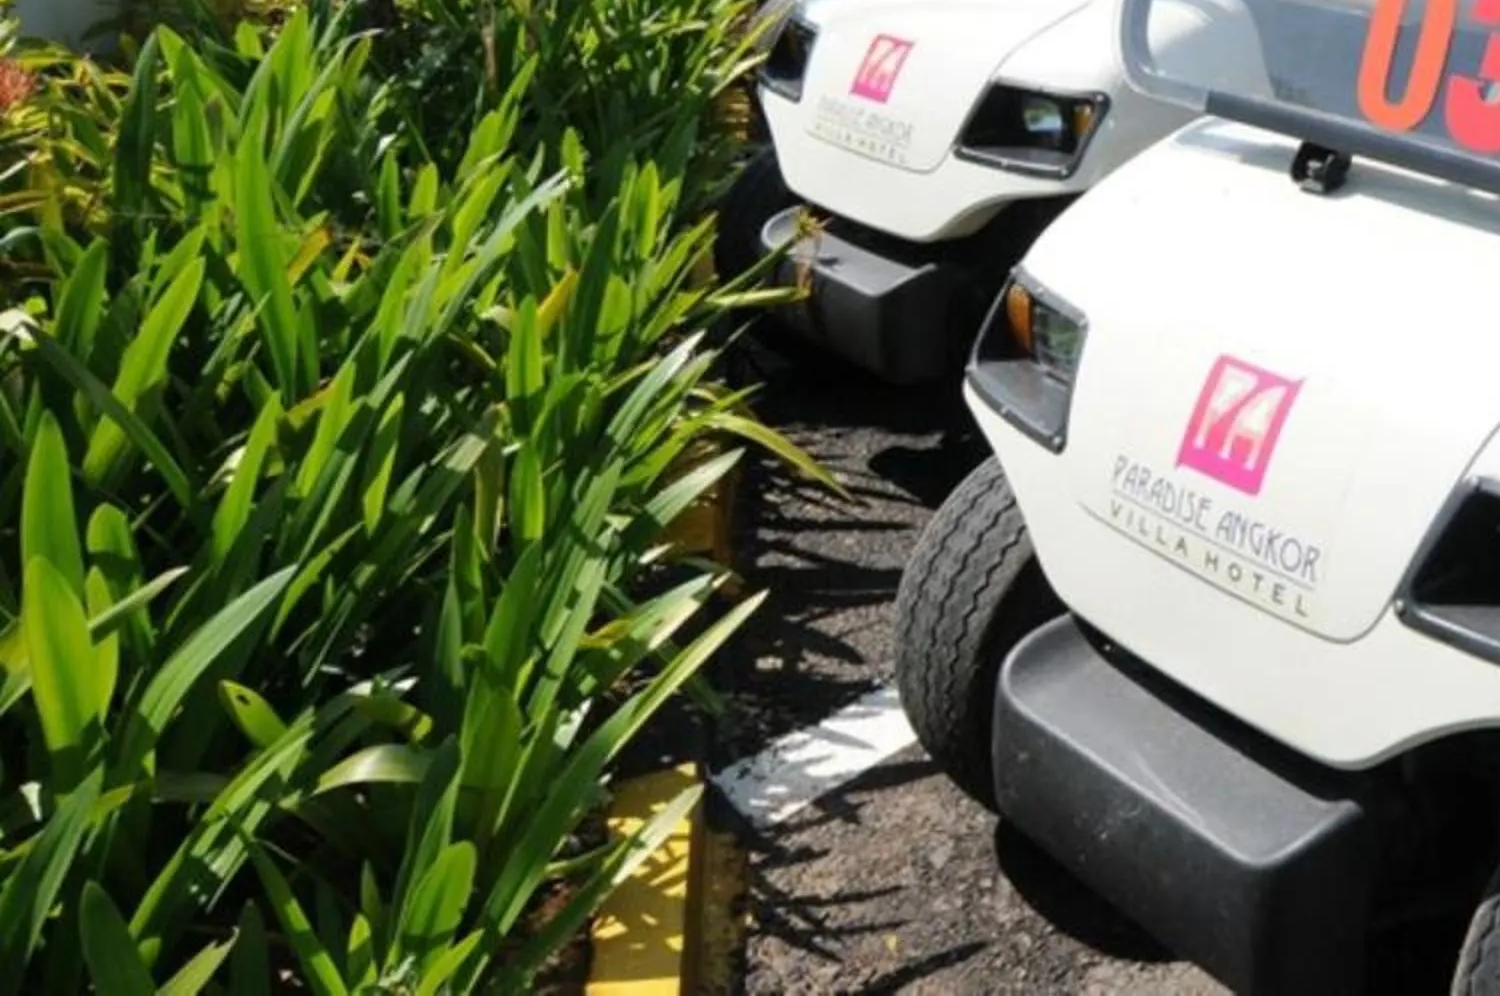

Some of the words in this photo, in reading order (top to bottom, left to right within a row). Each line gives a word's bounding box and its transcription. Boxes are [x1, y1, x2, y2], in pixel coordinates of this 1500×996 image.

[1111, 500, 1188, 556] VILLA
[1204, 551, 1307, 617] HOTEL
[1113, 455, 1212, 531] PARADISE
[1217, 510, 1320, 582] ANGKOR
